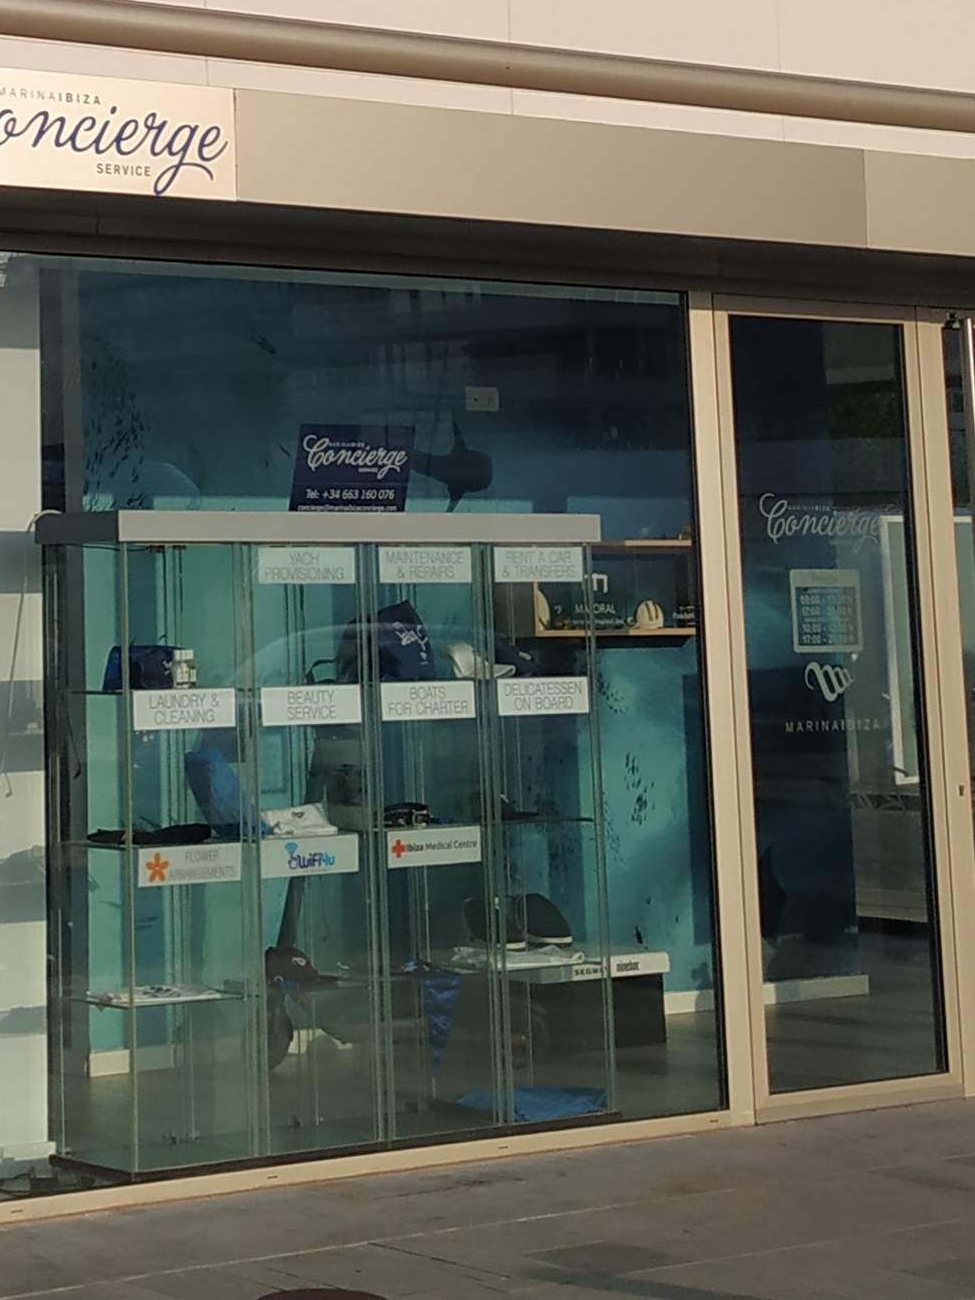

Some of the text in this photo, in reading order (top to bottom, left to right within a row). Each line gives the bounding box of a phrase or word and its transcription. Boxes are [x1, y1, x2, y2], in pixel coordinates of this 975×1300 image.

[96, 162, 153, 178] SERVICE
[302, 434, 409, 480] Concierge
[759, 492, 882, 555] Concierge
[385, 550, 465, 565] MAINTENANCE
[504, 550, 572, 564] RENT A CAR
[264, 566, 344, 581] PROVISIONING
[396, 565, 455, 578] & REPAIRS
[513, 564, 576, 577] TRANSFERS
[409, 685, 447, 700] BOATS
[503, 682, 583, 697] DELICATESSEN
[149, 693, 220, 710] LAUNDRY &
[287, 691, 335, 706] BEAUTY
[513, 696, 575, 711] ON BOARD
[287, 706, 338, 721] SERVICE
[388, 701, 469, 717] FOR CHARTER
[154, 710, 216, 726] CLEANING
[784, 718, 882, 733] MARINAIBIZA
[425, 840, 453, 851] Medical
[453, 839, 478, 849] Centre
[185, 850, 219, 863] FLOWER
